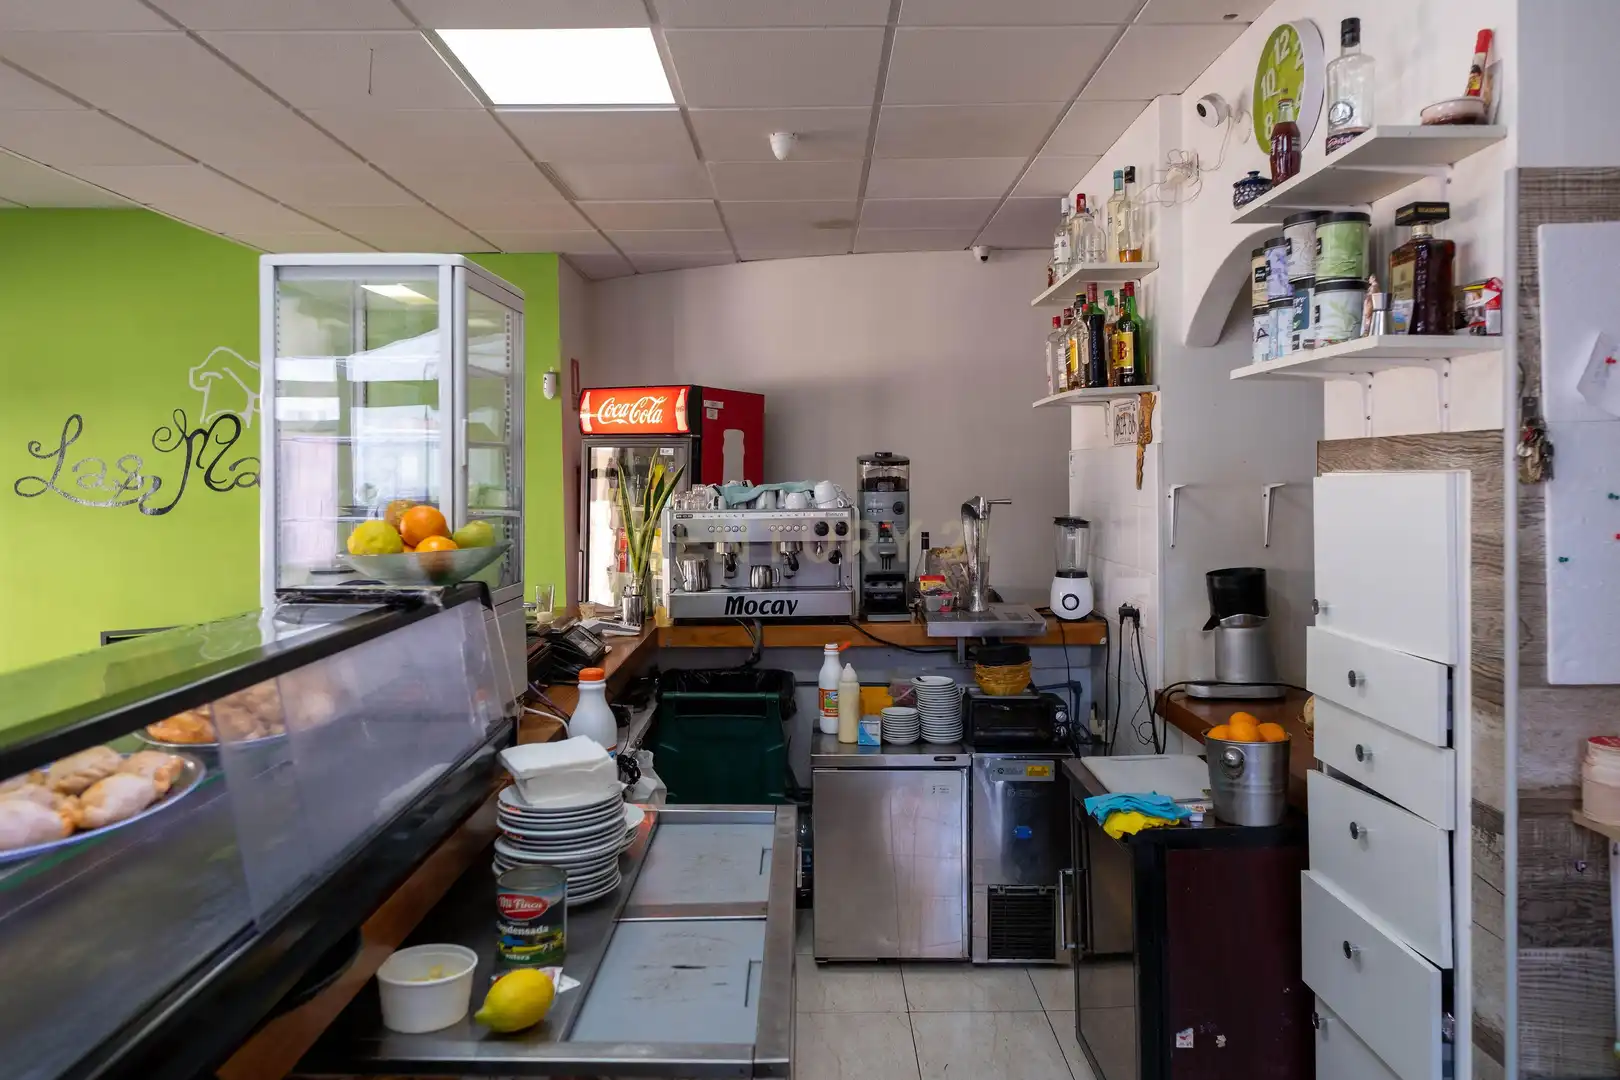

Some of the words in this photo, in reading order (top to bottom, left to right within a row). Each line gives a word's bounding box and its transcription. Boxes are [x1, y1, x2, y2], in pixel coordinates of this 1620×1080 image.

[1274, 29, 1290, 65] 12
[1261, 67, 1276, 101] 10
[724, 595, 798, 616] Mocav
